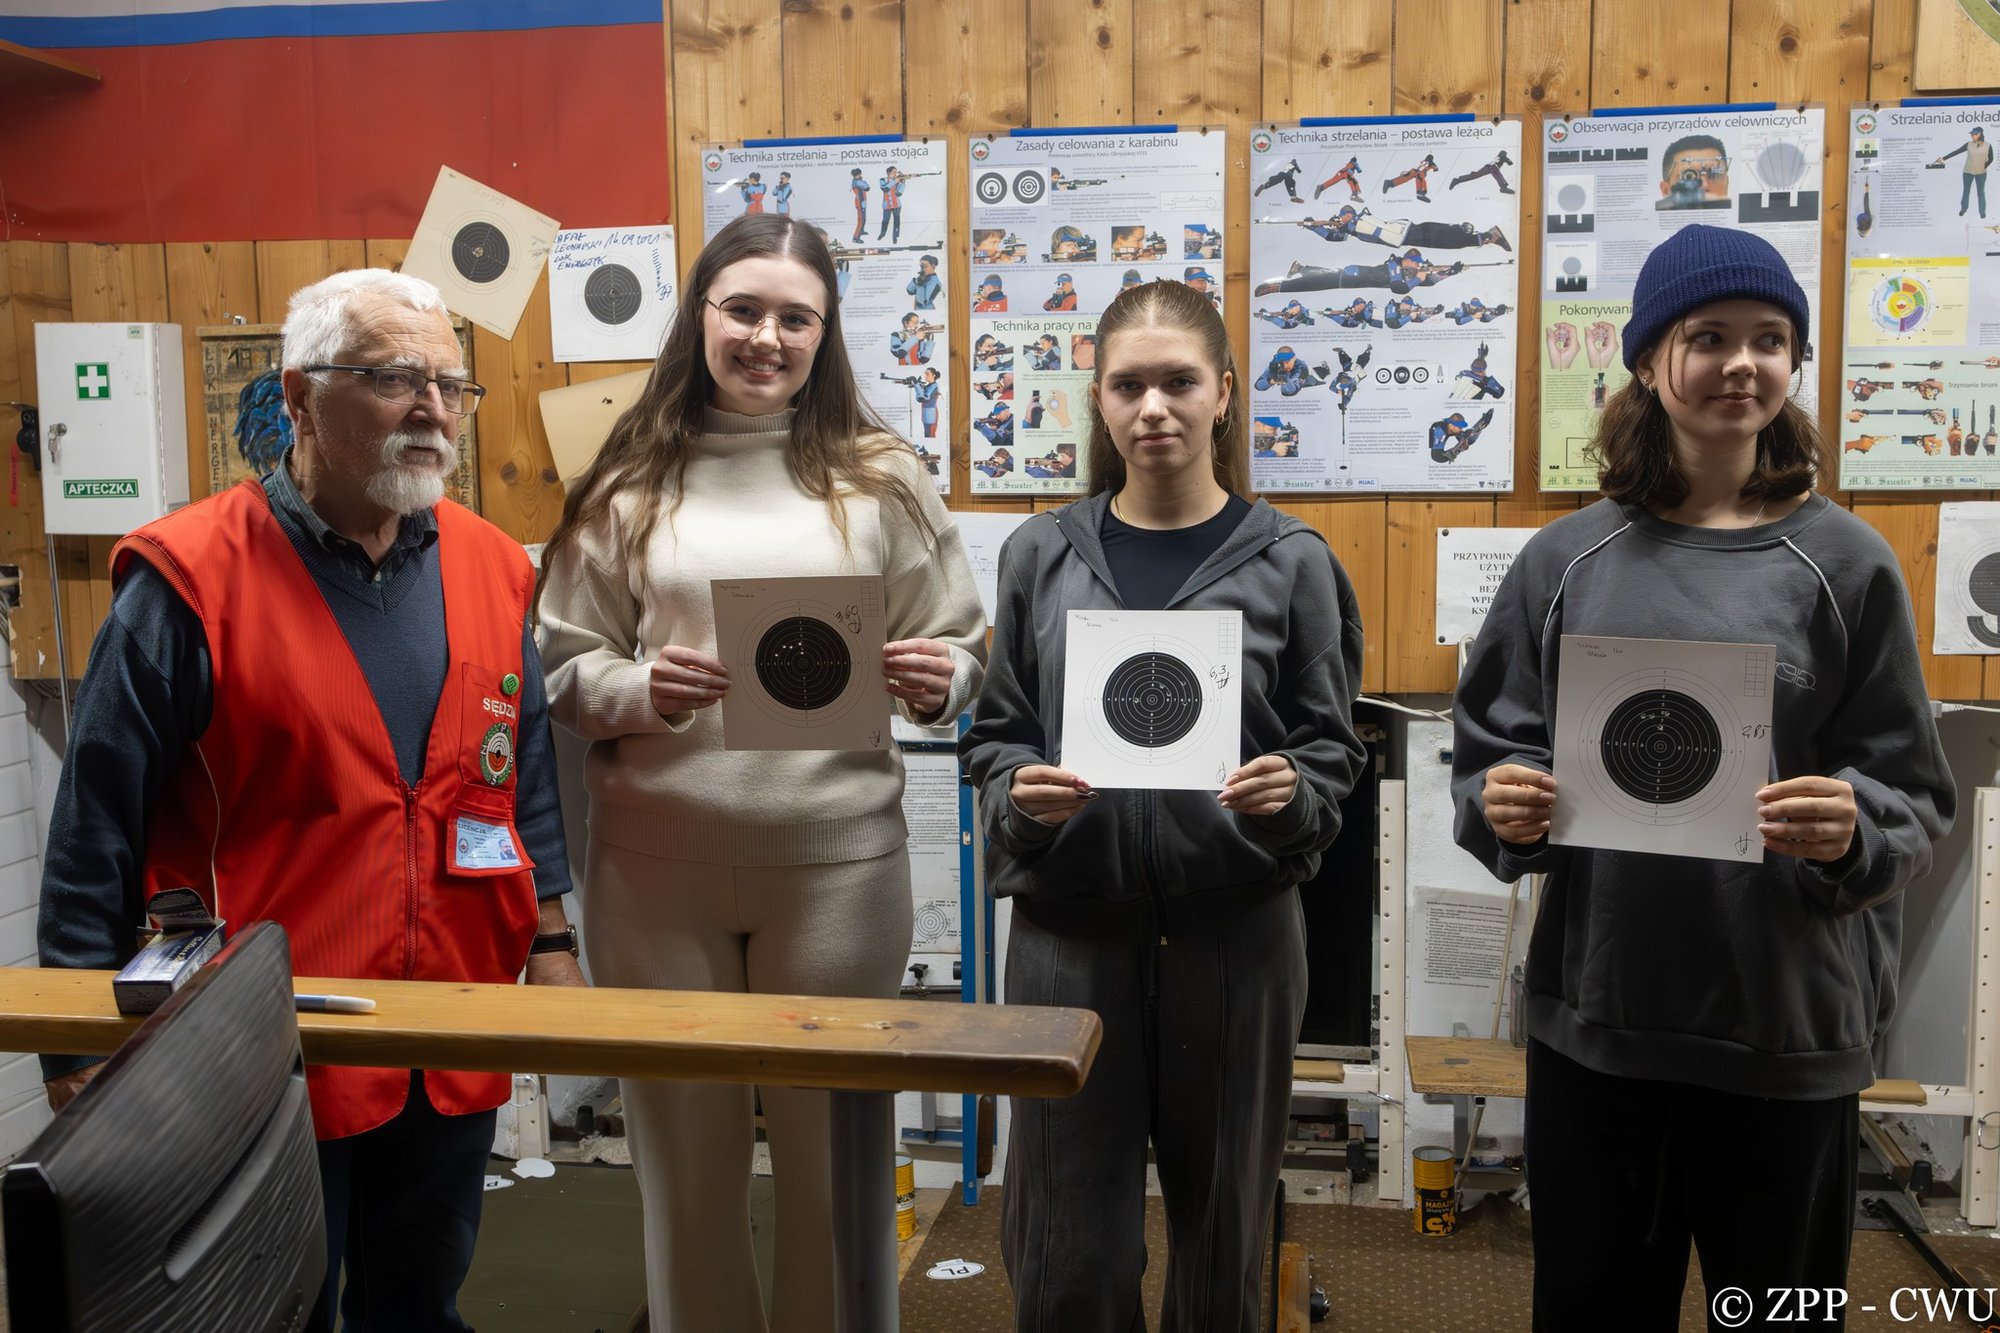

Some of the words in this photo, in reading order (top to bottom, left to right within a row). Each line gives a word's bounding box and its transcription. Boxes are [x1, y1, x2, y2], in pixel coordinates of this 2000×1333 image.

[1573, 121, 1644, 134] Obserwacja
[1648, 117, 1721, 132] przyrządów
[1724, 115, 1807, 129] celowniczych
[1891, 112, 1952, 125] Strzelania
[1278, 131, 1328, 144] Technika
[1331, 130, 1387, 142] strzelania
[1401, 128, 1453, 141] postawa
[1456, 125, 1493, 140] leżąca
[1016, 140, 1055, 154] Zasady
[1058, 139, 1115, 152] celowania
[1118, 140, 1125, 149] z
[1128, 137, 1179, 149] karabinu
[729, 151, 774, 164] Technika
[777, 148, 827, 161] strzelania
[840, 148, 888, 160] postawa
[890, 145, 929, 159] stojąca
[991, 319, 1040, 331] Technika
[1044, 321, 1074, 333] pracy
[1078, 321, 1092, 330] na
[68, 482, 134, 495] APTECZKA
[458, 823, 487, 835] LICENCJA
[940, 1266, 970, 1276] PL
